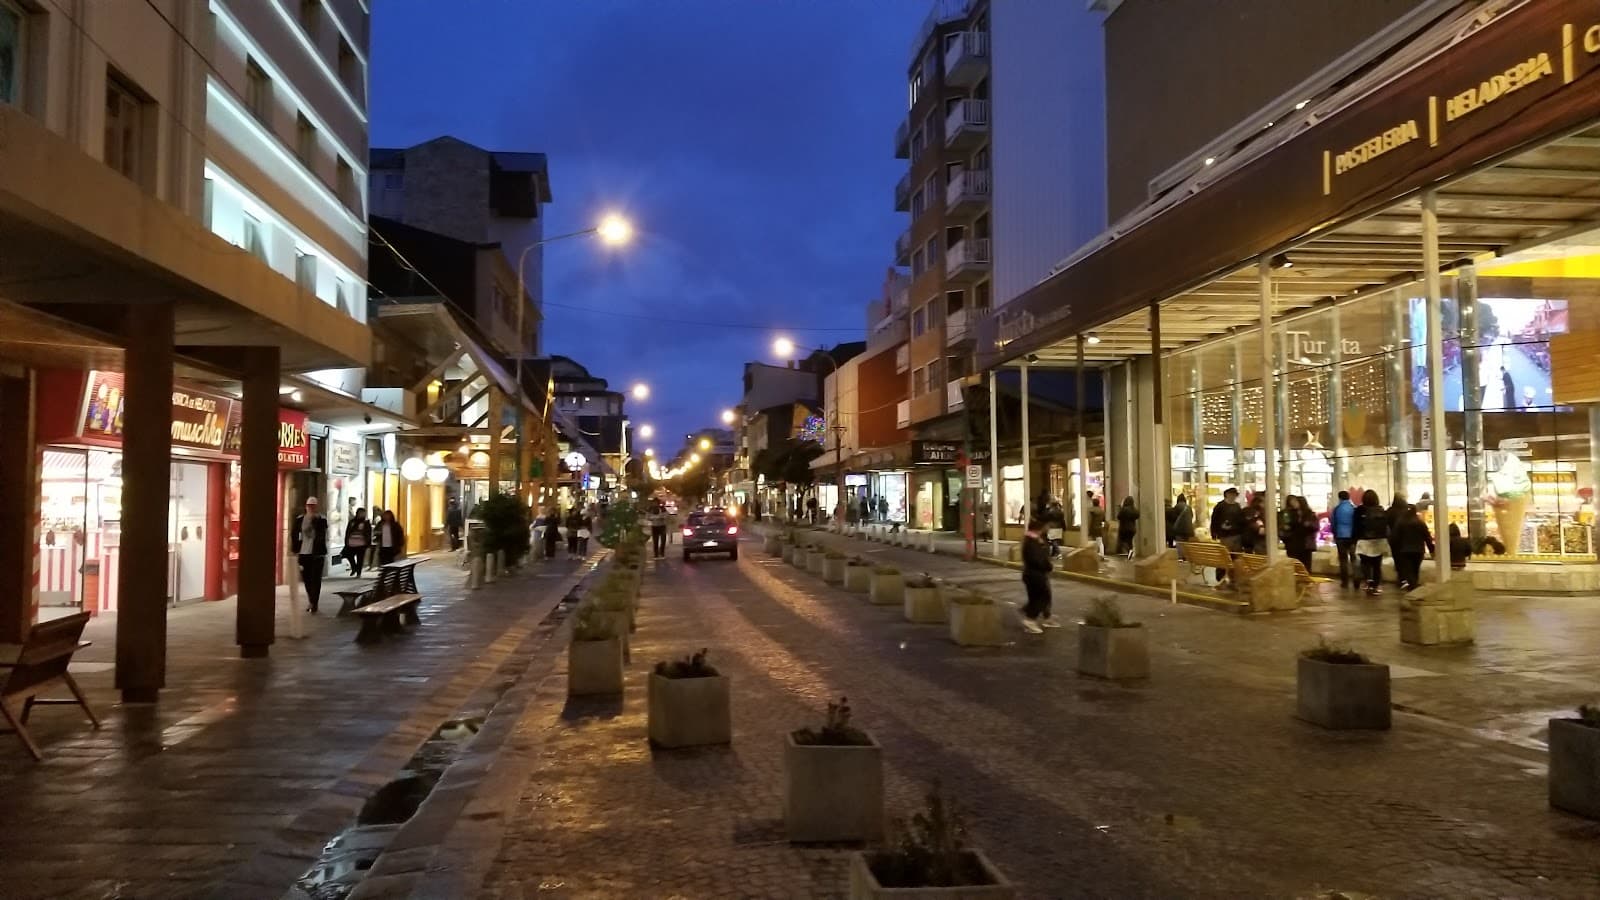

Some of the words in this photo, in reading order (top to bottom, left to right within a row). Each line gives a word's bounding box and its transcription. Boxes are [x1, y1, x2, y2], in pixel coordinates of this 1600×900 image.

[1335, 120, 1420, 175] PASTELERIA
[1446, 52, 1553, 122] HELADERIA
[1286, 330, 1362, 360] Turta
[171, 411, 222, 446] muschka
[278, 422, 306, 448] RRES
[278, 452, 303, 464] OLATES
